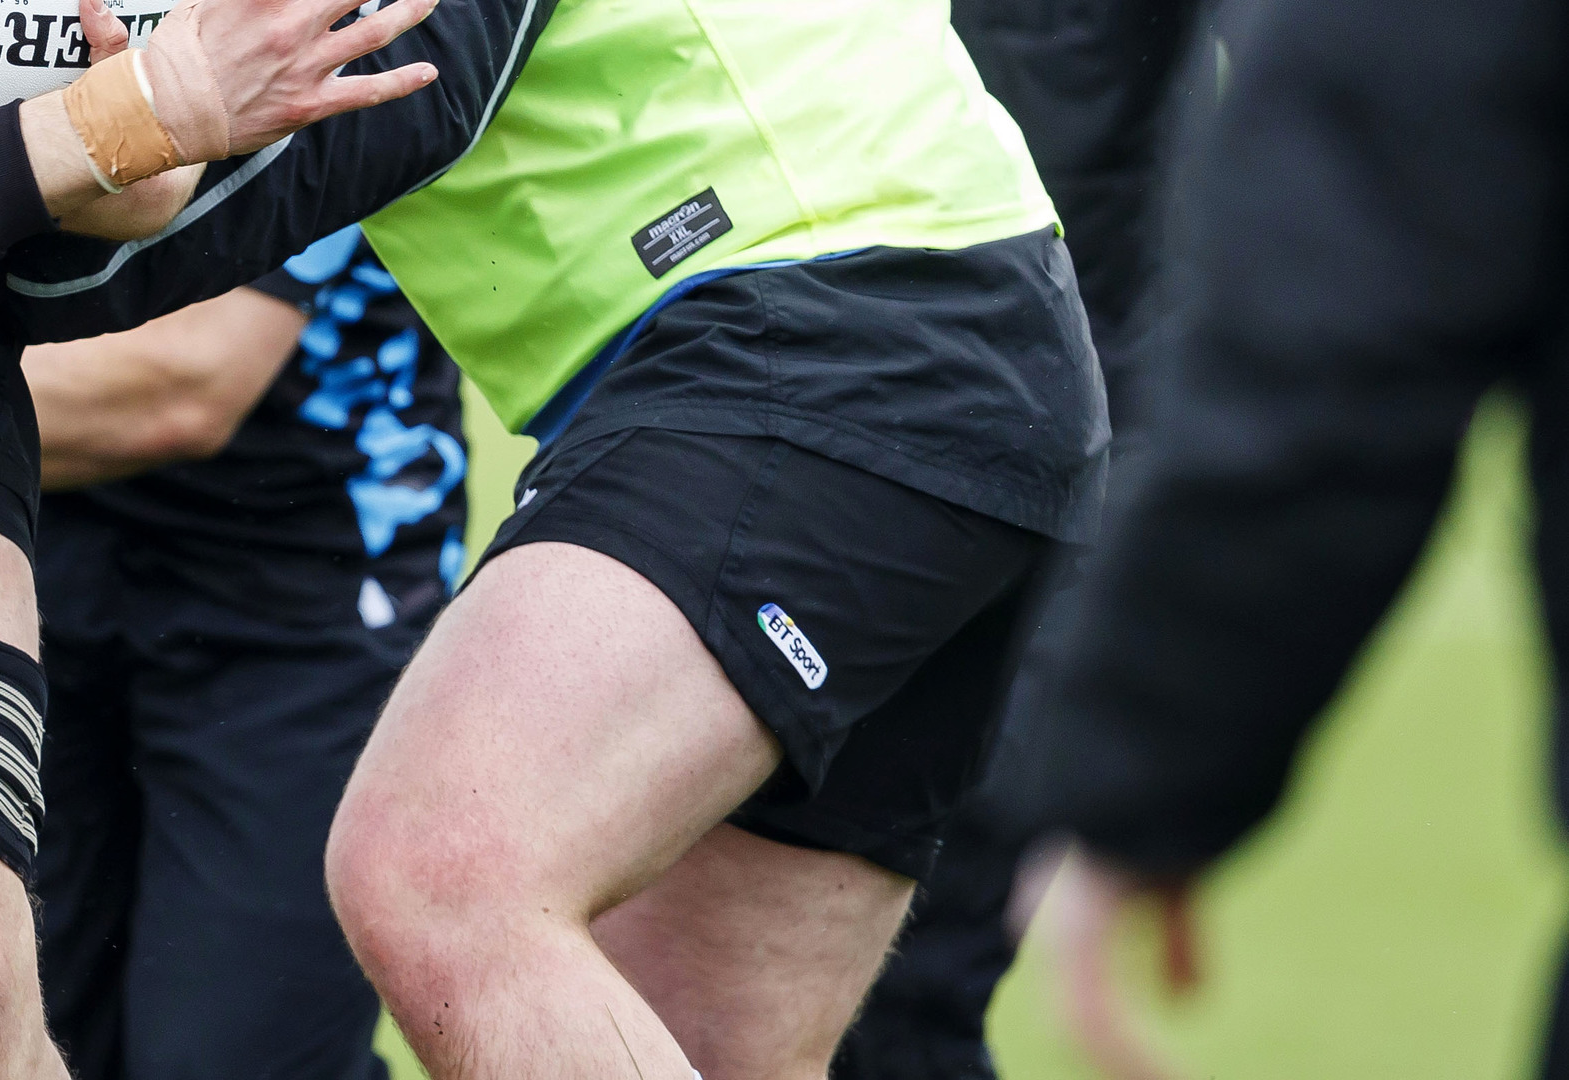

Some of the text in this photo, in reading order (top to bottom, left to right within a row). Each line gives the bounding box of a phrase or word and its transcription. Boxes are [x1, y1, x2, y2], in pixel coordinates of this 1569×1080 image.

[648, 201, 701, 240] macron
[669, 225, 692, 245] XXL
[768, 613, 821, 680] BT Sport
